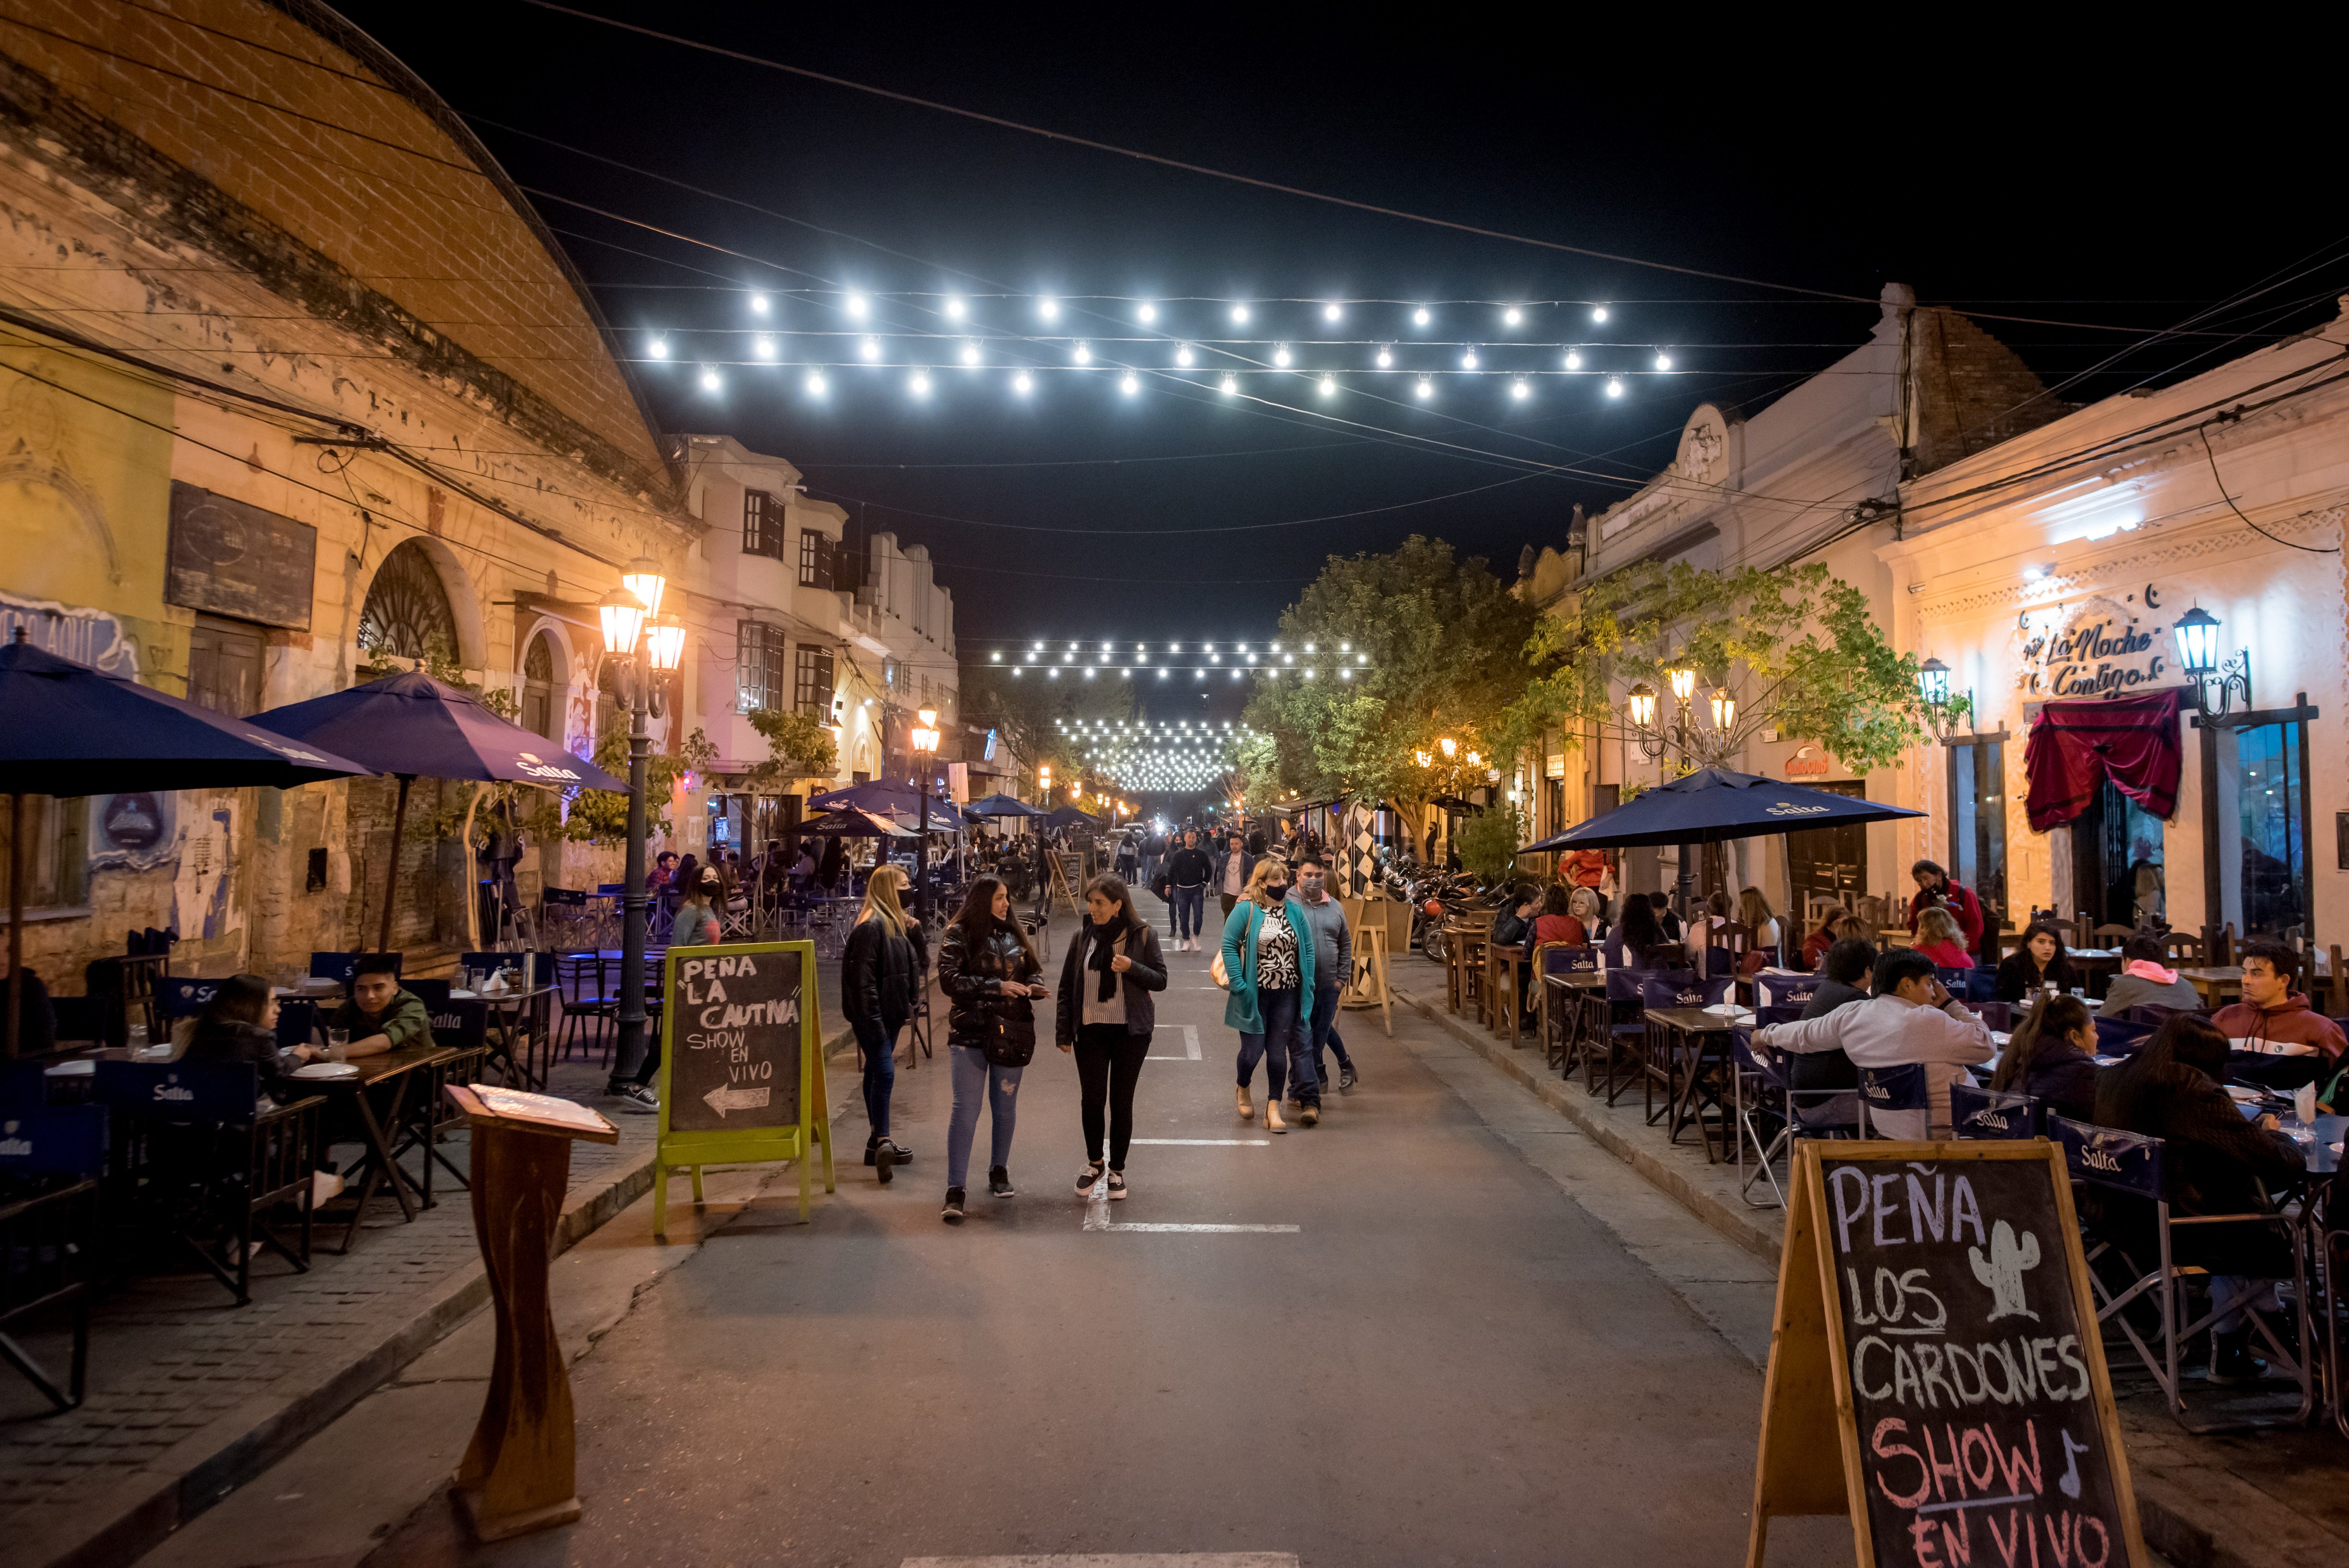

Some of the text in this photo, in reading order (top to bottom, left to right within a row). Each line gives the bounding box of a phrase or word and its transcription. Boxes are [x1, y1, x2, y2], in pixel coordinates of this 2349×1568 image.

[2046, 632, 2074, 666] La
[2074, 623, 2152, 662] Noche
[516, 761, 582, 780] Salta
[824, 801, 847, 809] Salta
[1766, 805, 1830, 815] Salta
[930, 815, 952, 823] Salta
[683, 956, 757, 982] PEÑA
[1571, 959, 1594, 969] Salta
[1676, 993, 1704, 1004] Salta
[433, 1013, 462, 1029] alta
[687, 1030, 746, 1050] SHOW
[731, 1045, 748, 1063] EN
[728, 1061, 773, 1083] VIVO
[153, 1083, 194, 1101] Salta
[1864, 1081, 1891, 1099] Salta
[1976, 1109, 2010, 1130] Salta
[2080, 1144, 2123, 1172] Salta
[1826, 1163, 1986, 1253] PEÑA
[1846, 1266, 1947, 1327] LOS
[1854, 1334, 2089, 1410] CARDONES
[1871, 1417, 2044, 1509] SHOW
[1908, 1507, 2110, 1568] EN VIVO
